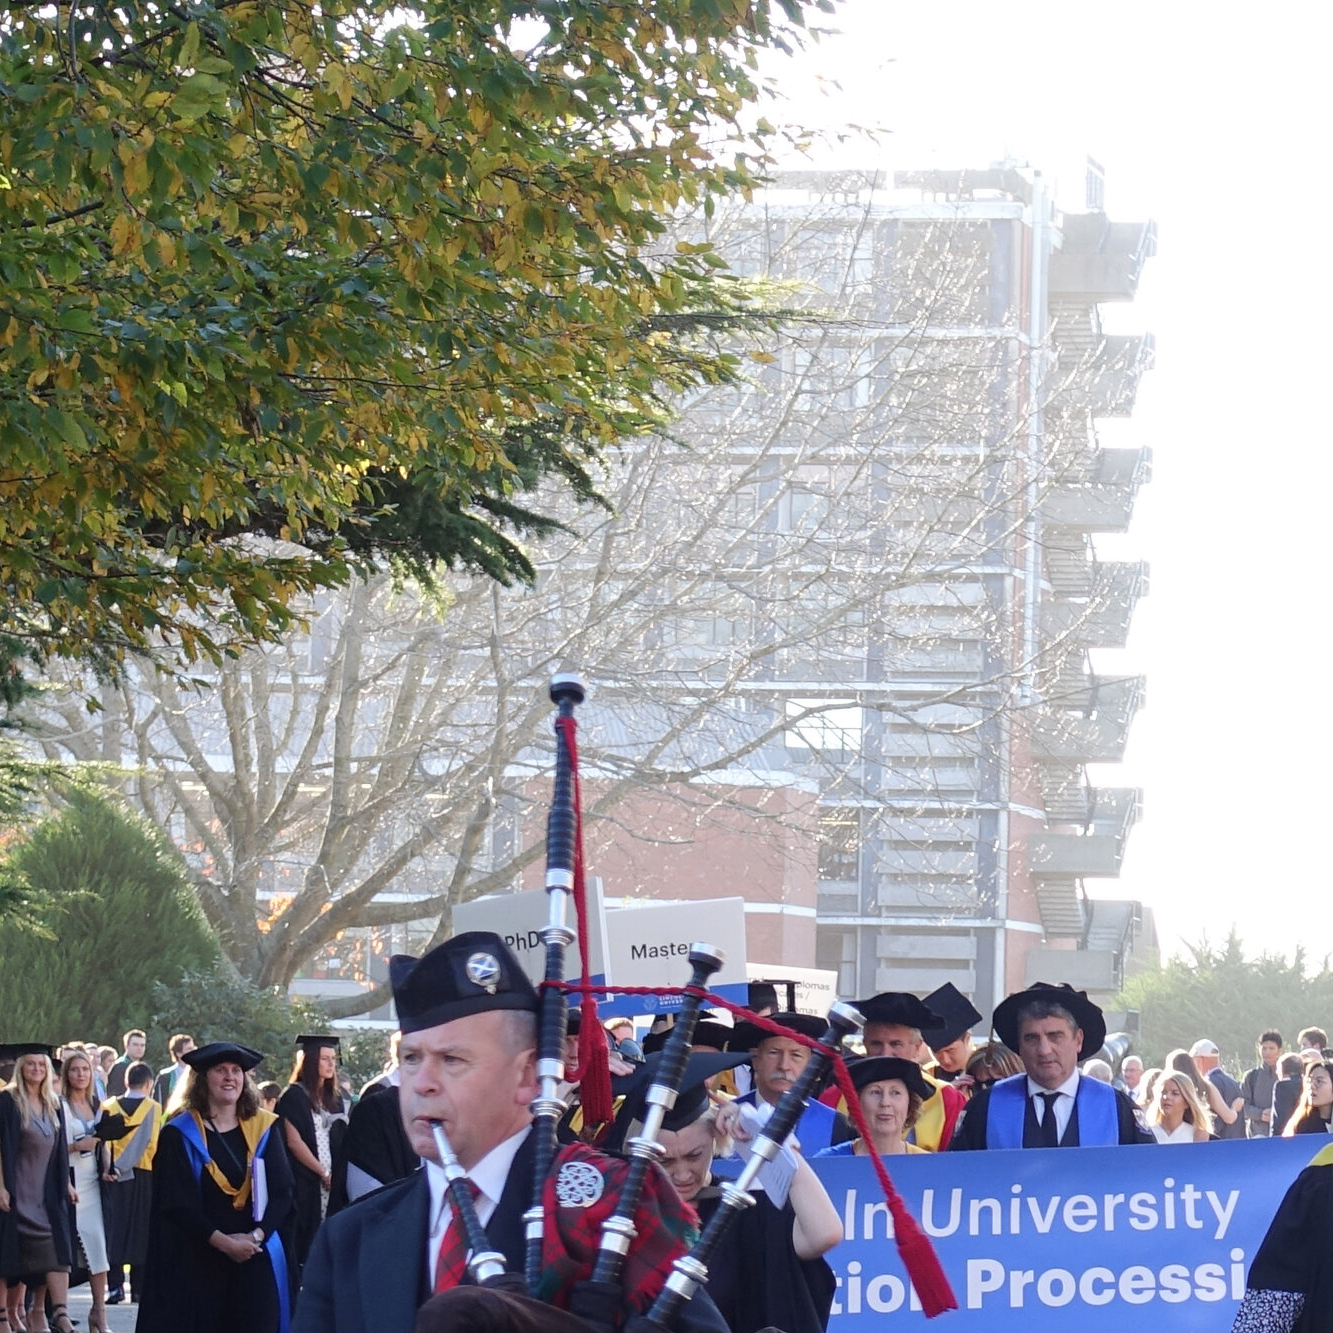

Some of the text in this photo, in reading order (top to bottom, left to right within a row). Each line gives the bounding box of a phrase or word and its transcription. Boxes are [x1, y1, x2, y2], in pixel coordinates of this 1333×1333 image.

[505, 930, 540, 951] PhD
[922, 1177, 1240, 1239] University
[967, 1247, 1245, 1310] Processi
